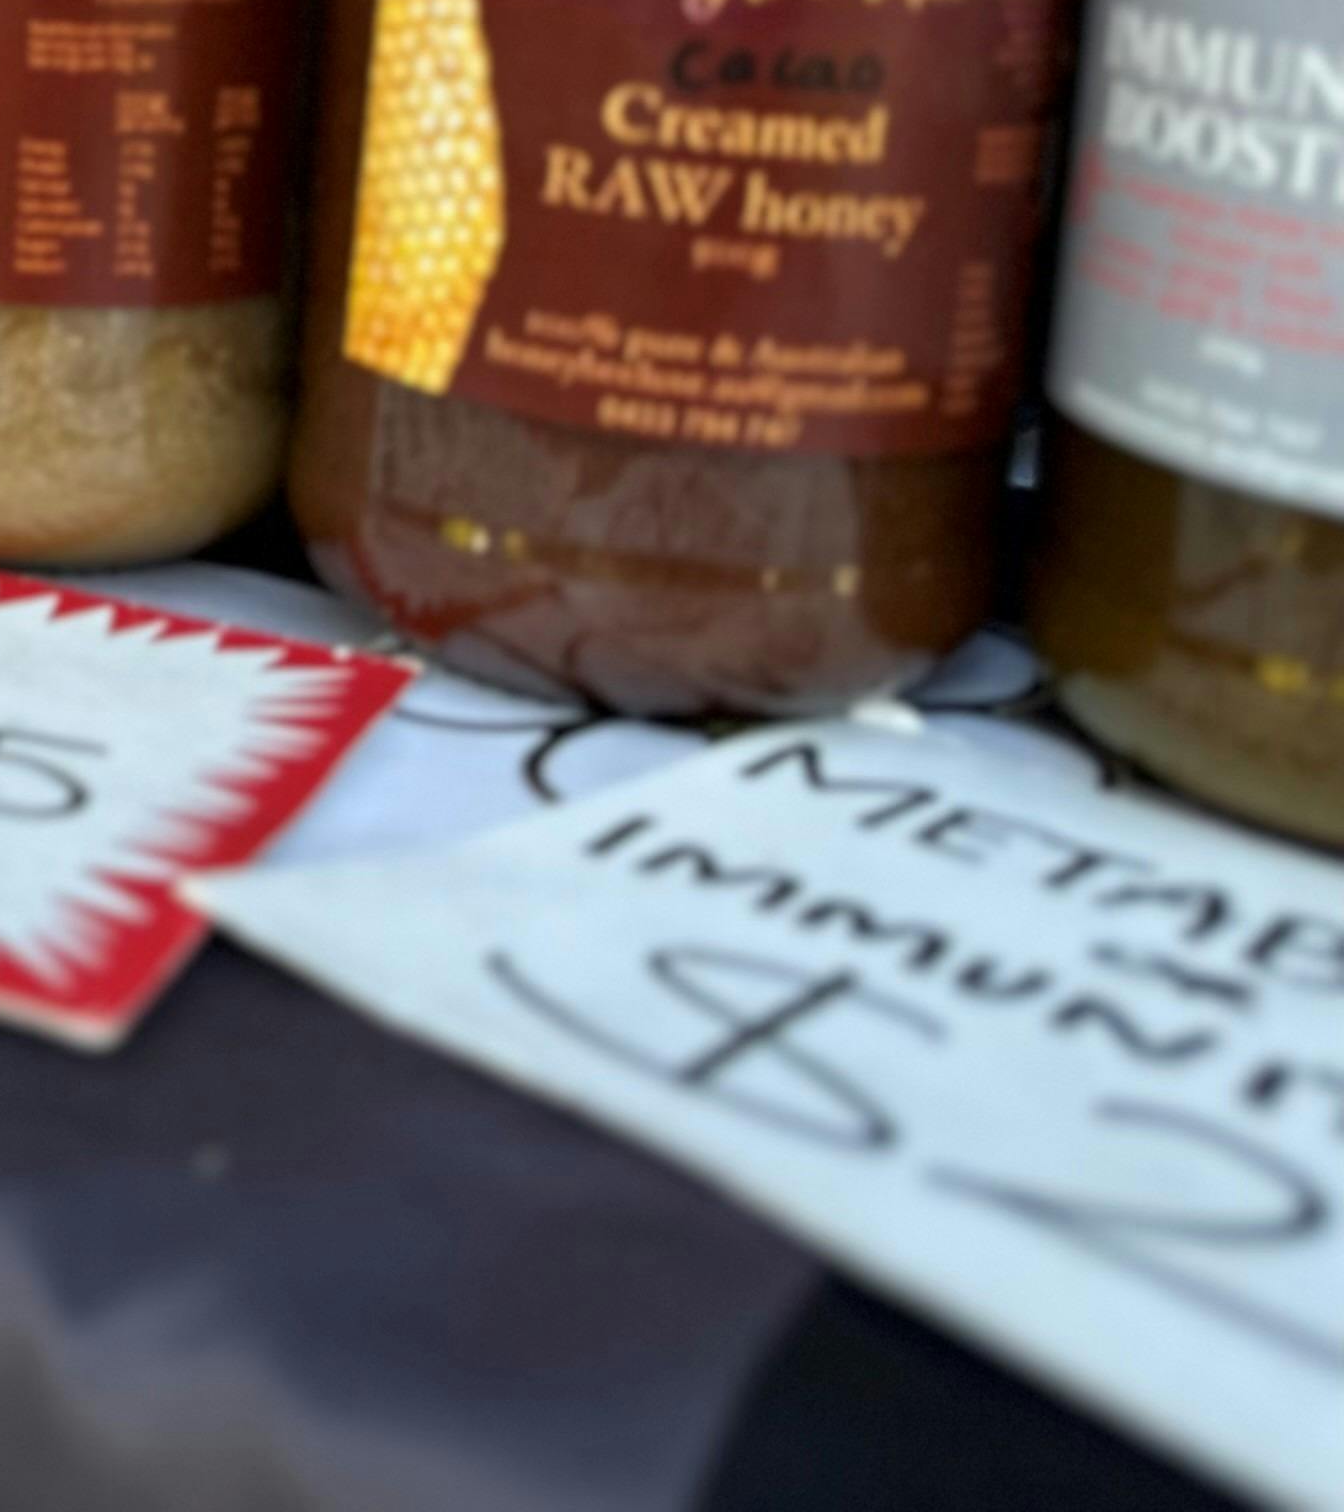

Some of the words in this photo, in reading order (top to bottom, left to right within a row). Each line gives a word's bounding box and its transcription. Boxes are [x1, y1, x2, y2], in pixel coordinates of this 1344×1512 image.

[602, 80, 890, 165] Creamed
[542, 144, 734, 225] RAW
[740, 170, 926, 259] honey
